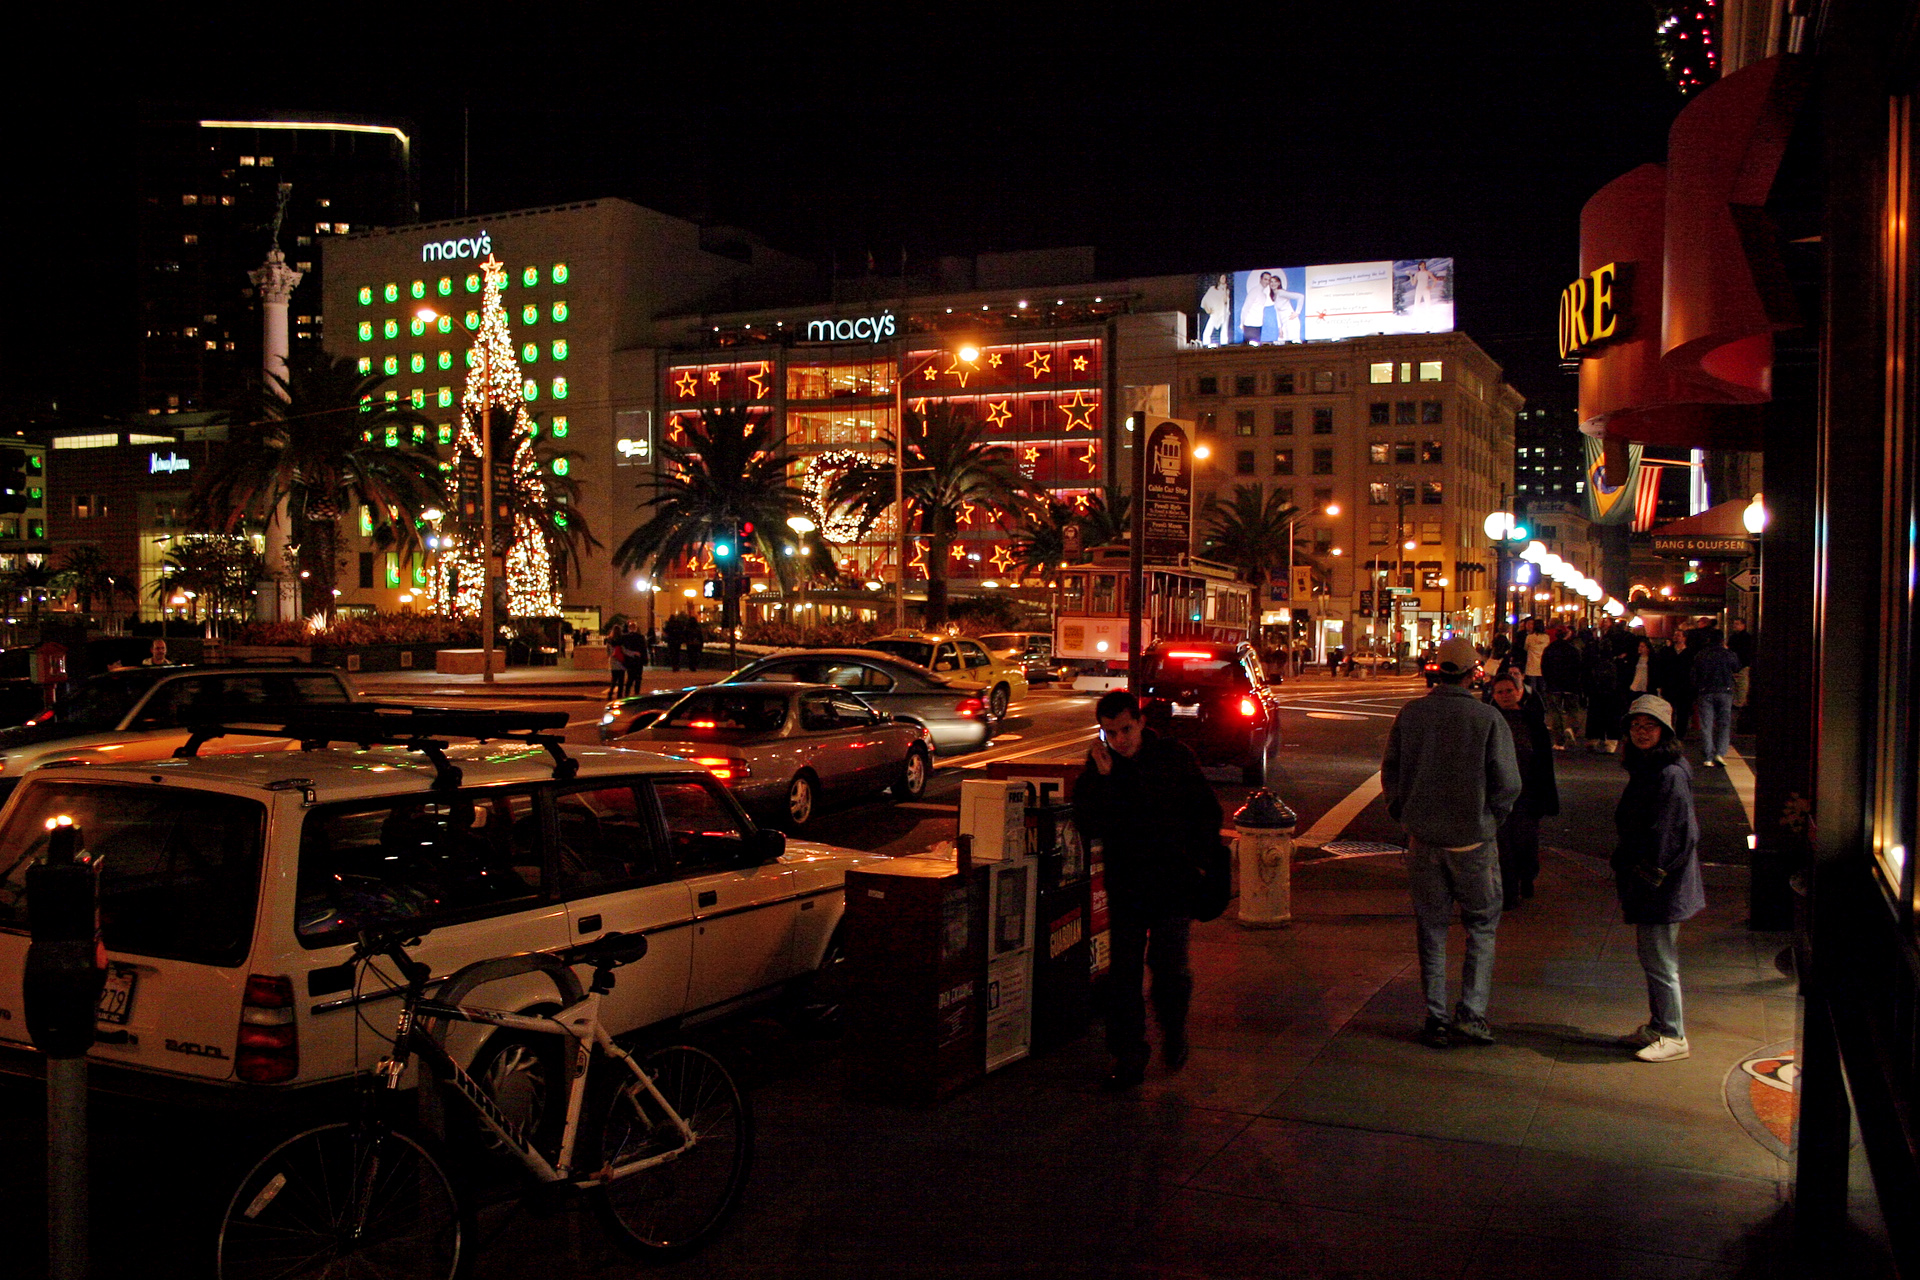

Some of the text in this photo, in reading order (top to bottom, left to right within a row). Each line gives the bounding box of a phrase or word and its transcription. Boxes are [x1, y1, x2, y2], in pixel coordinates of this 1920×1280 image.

[423, 230, 491, 262] macy's
[808, 309, 895, 343] macy's
[1559, 262, 1616, 359] ORE
[1655, 540, 1745, 550] BANG & OLUFSEN
[1009, 792, 1023, 803] FREE
